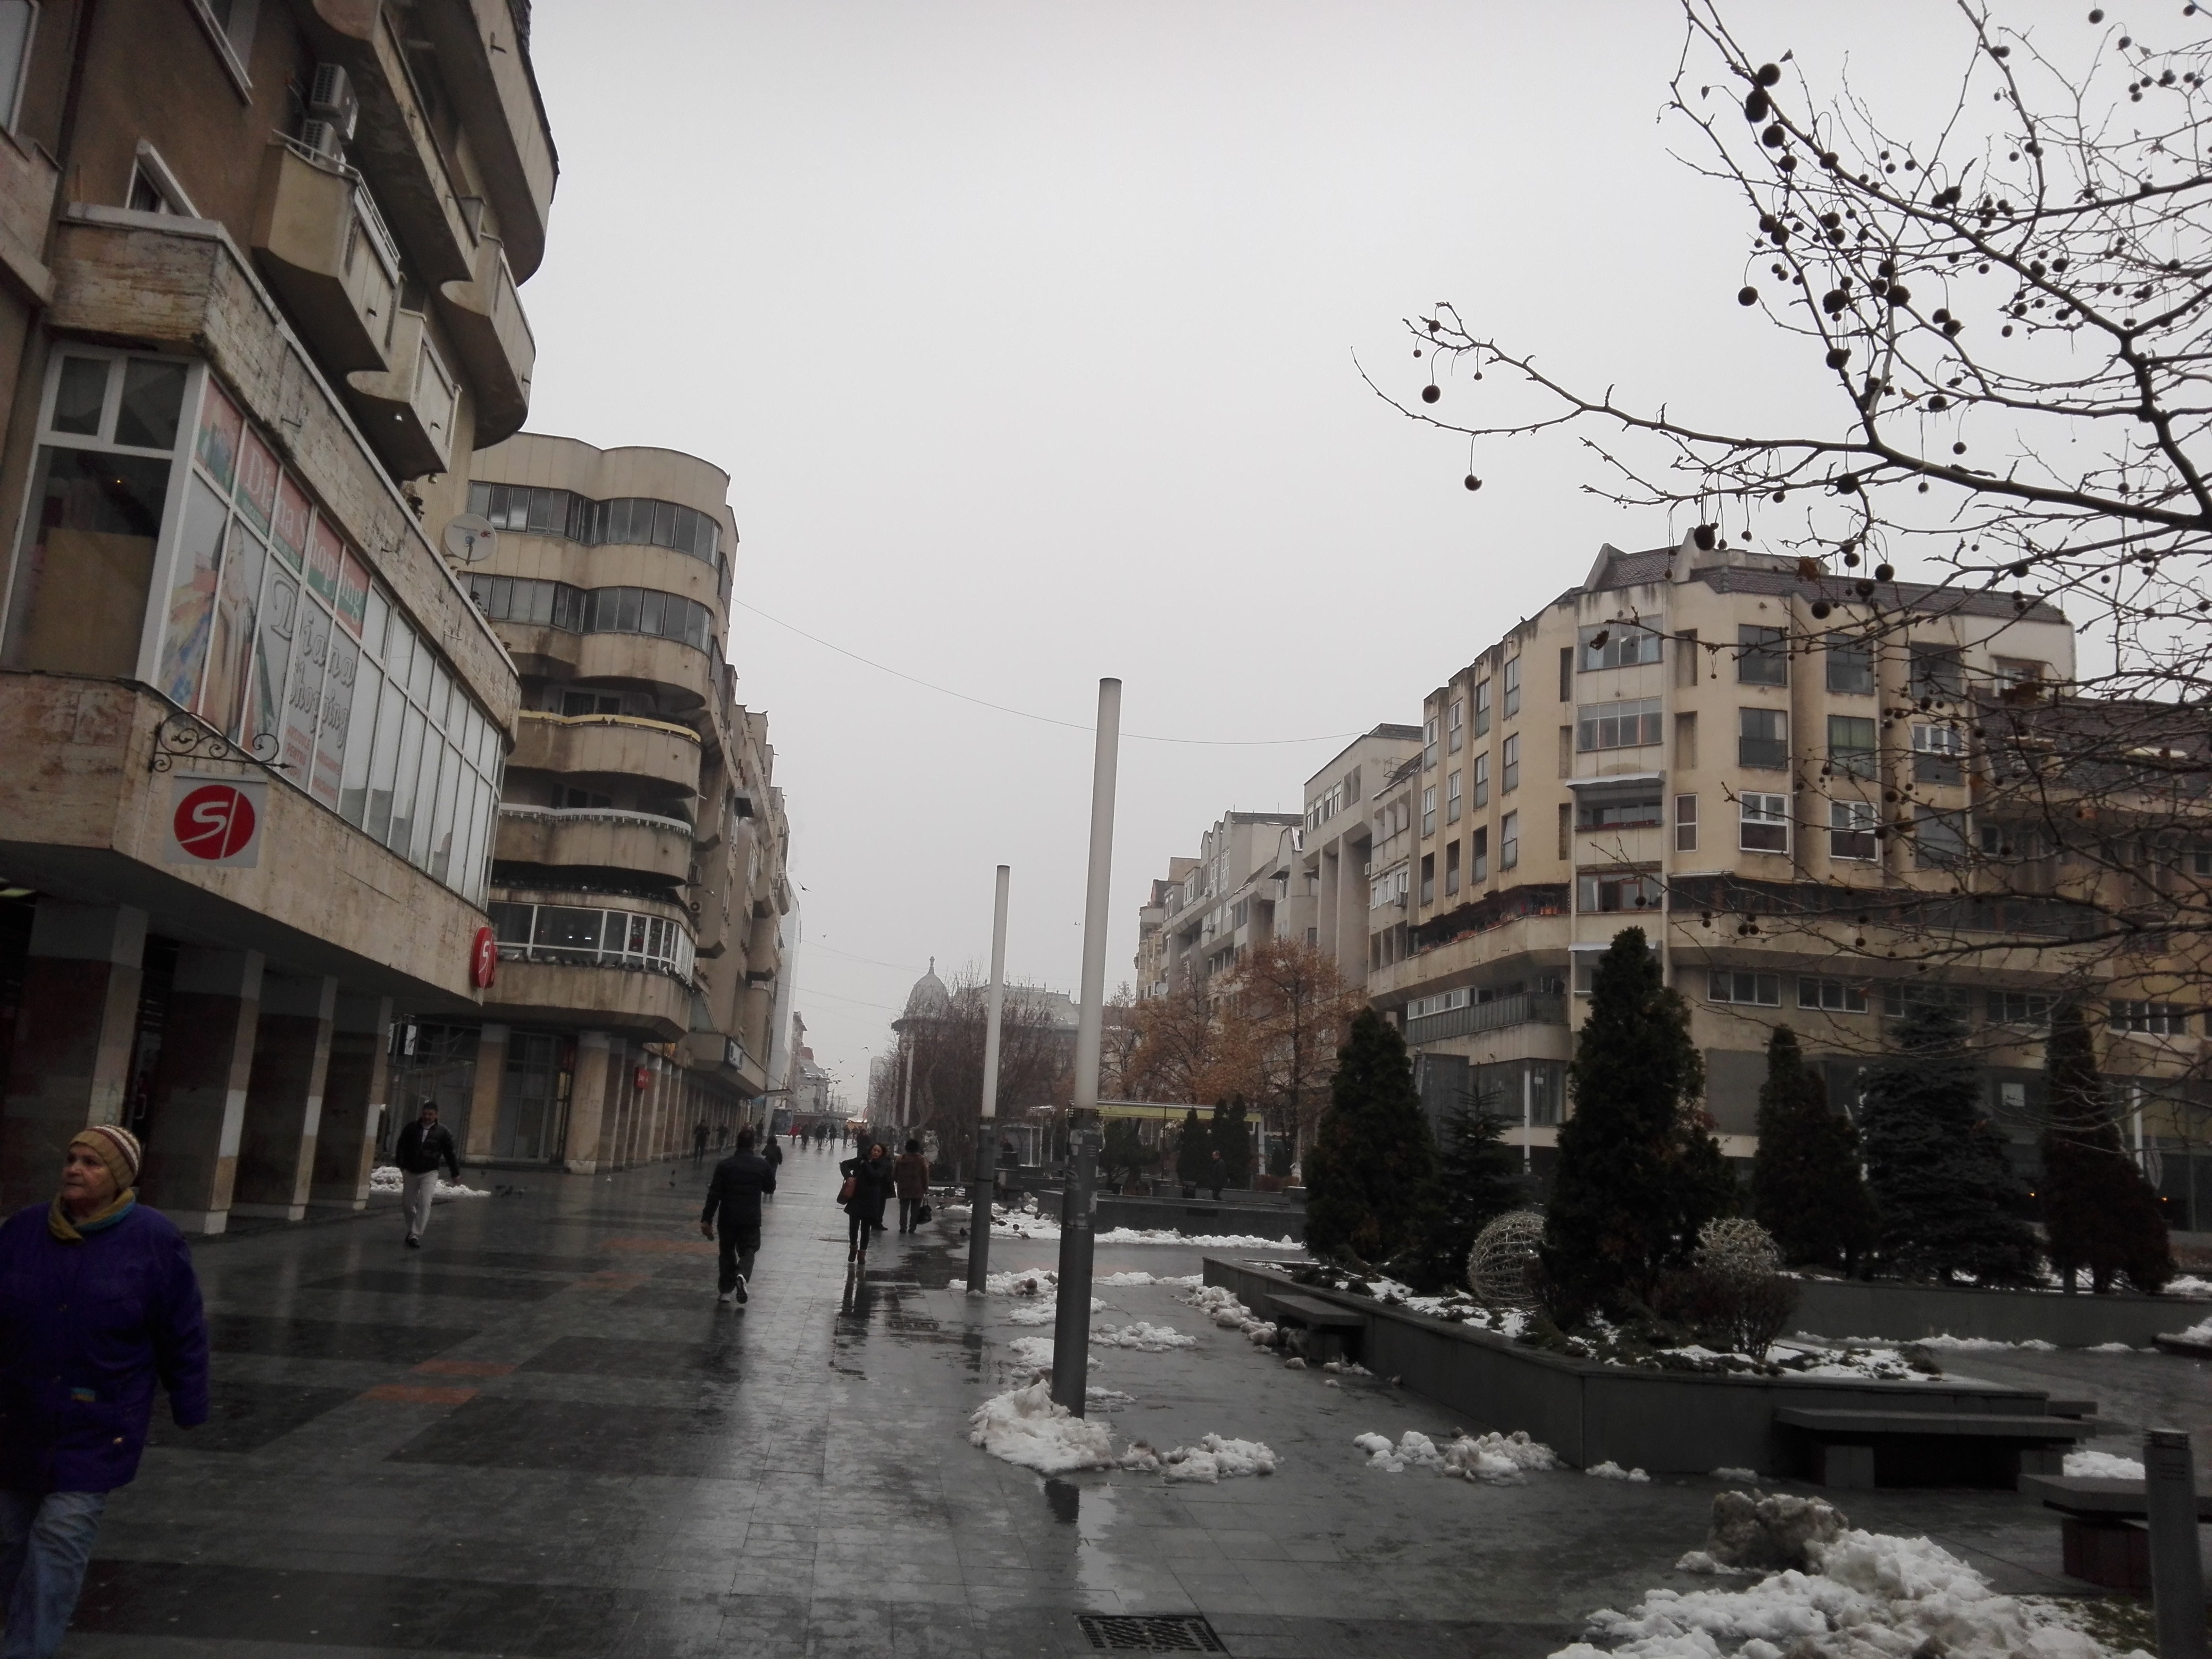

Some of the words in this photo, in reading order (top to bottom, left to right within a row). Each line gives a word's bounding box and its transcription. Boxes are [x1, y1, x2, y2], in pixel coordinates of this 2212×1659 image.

[246, 448, 294, 538] Diana
[295, 509, 364, 625] Shopping
[271, 572, 354, 689] Diana
